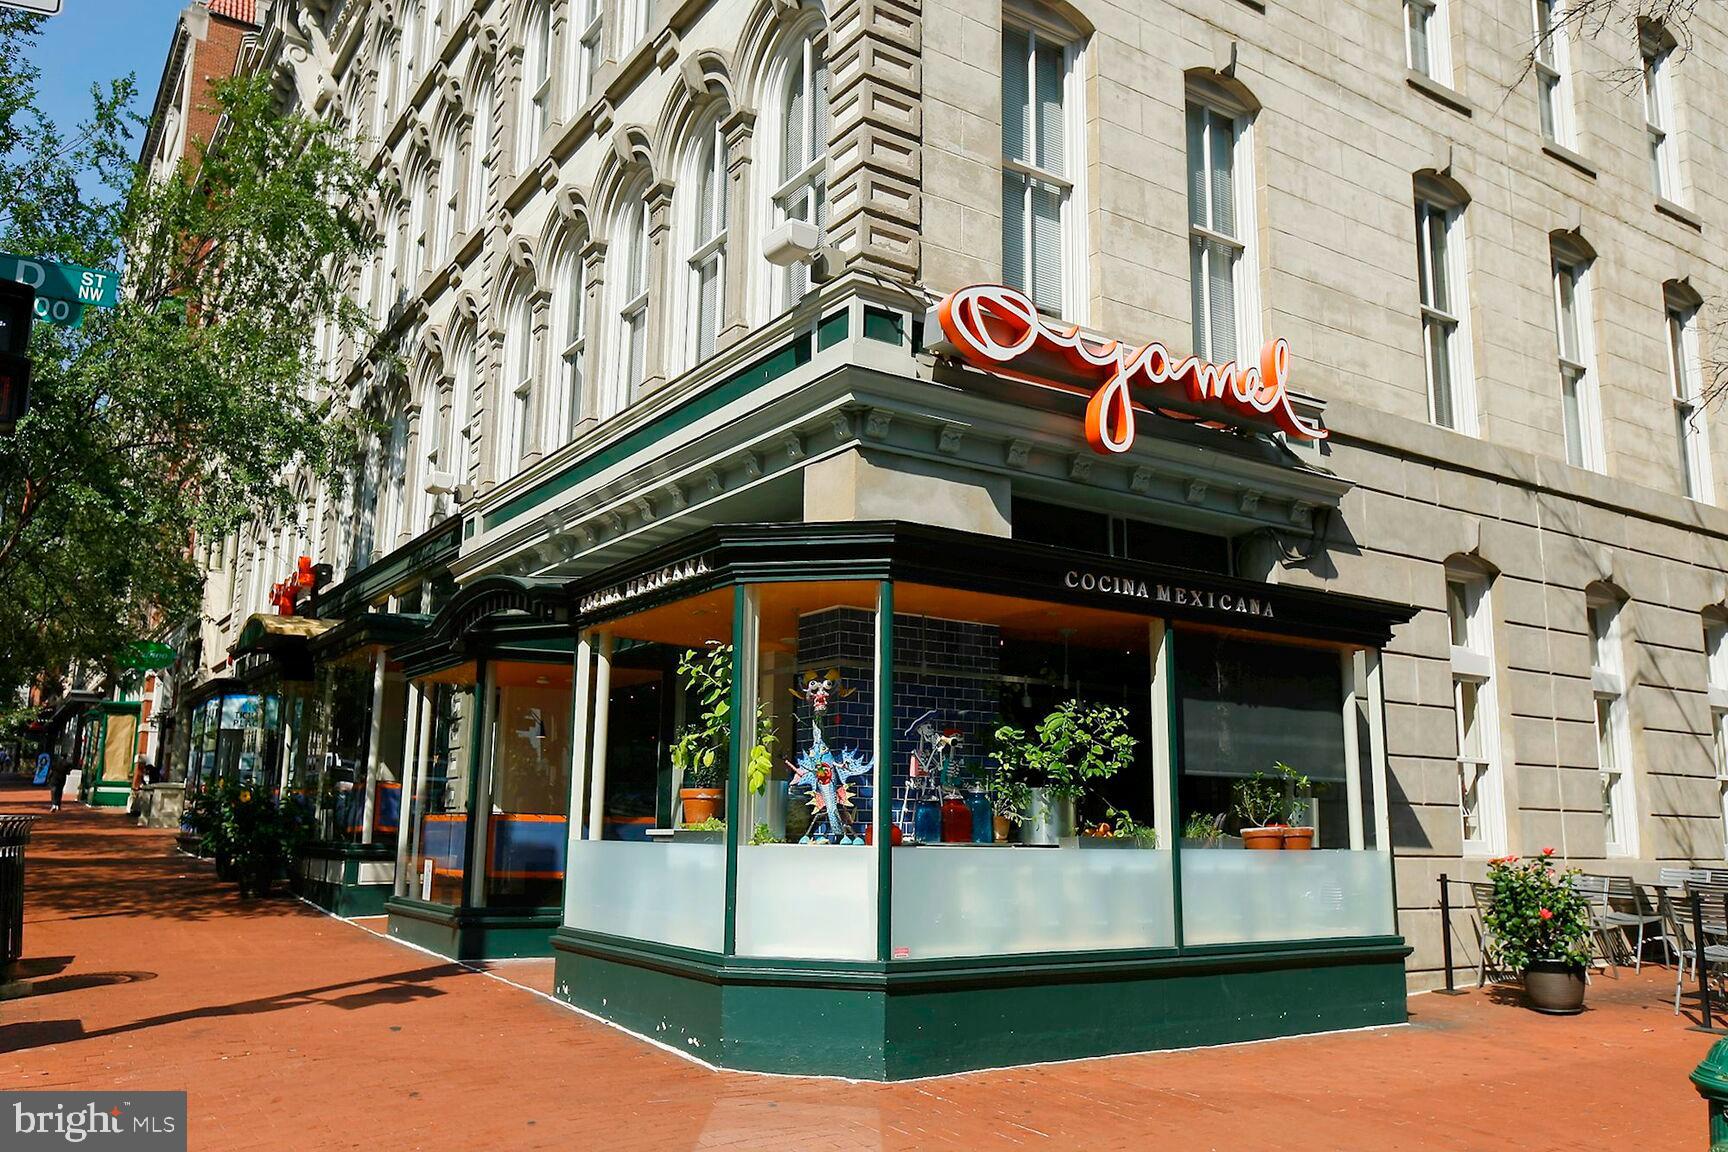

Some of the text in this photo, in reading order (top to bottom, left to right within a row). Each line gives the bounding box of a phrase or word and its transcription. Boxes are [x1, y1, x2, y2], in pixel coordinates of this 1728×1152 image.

[15, 259, 46, 289] D
[81, 272, 107, 288] ST
[33, 296, 70, 321] 00
[78, 286, 105, 302] NW
[938, 282, 1329, 456] Oyamel
[625, 556, 713, 598] MEXICANA
[1064, 571, 1275, 618] COCINA MEXICANA
